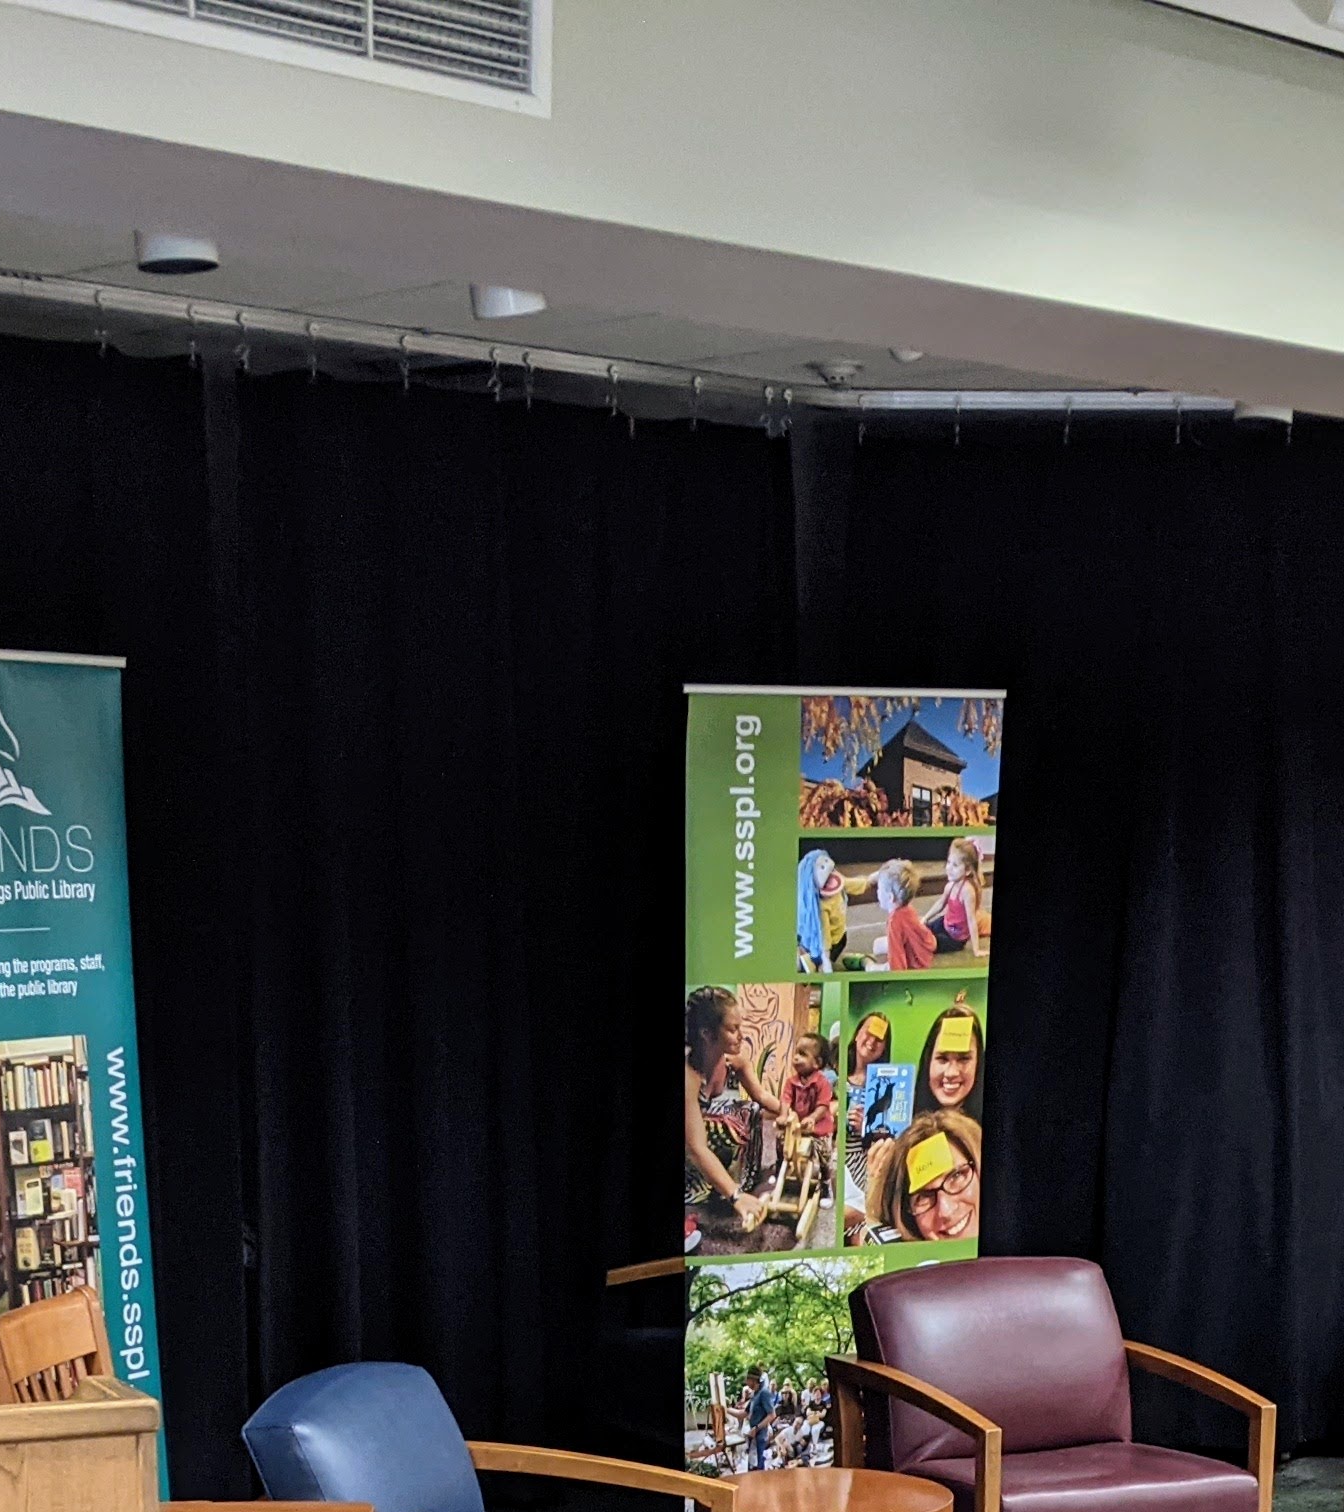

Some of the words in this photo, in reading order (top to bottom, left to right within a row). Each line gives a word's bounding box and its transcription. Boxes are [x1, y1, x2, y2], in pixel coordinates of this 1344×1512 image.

[730, 714, 763, 959] www.sspl.org
[13, 880, 50, 900] Public
[51, 879, 96, 902] Library
[13, 957, 29, 974] the
[30, 958, 79, 976] programs,
[80, 953, 106, 971] staff,
[0, 981, 17, 998] the
[17, 979, 46, 1000] public
[47, 979, 78, 997] library
